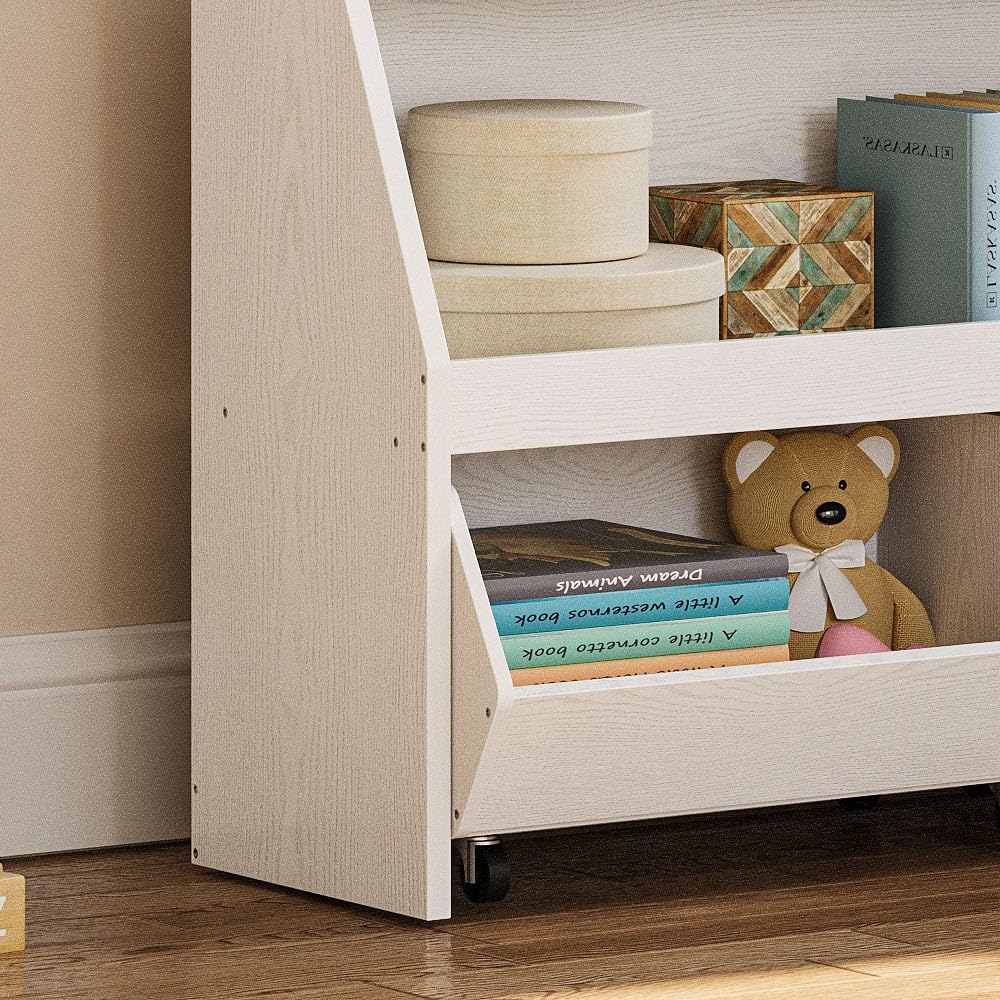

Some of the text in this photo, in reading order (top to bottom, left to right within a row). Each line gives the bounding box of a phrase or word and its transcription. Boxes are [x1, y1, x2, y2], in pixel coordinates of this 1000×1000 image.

[556, 567, 704, 594] Dream Animals
[514, 594, 744, 627] A little westernos book
[522, 629, 738, 662] A little cornetto book
